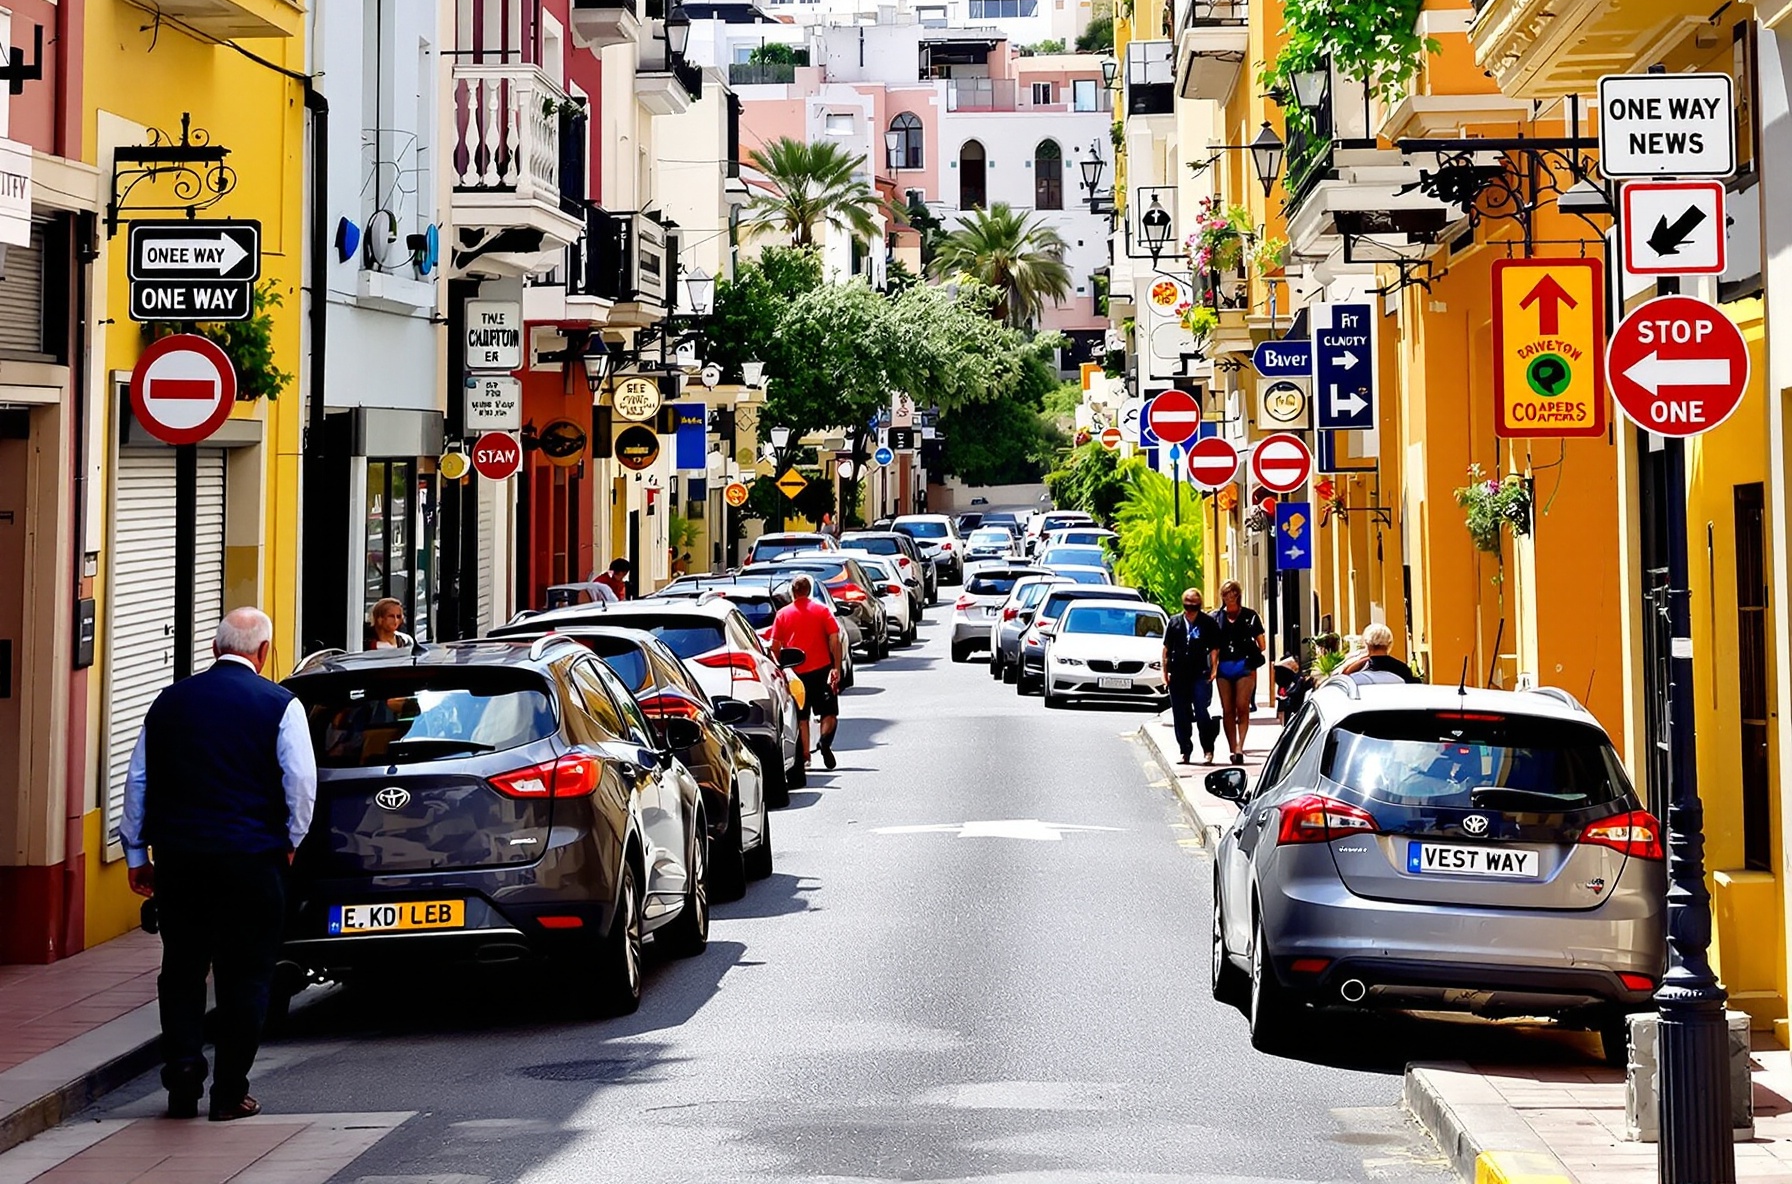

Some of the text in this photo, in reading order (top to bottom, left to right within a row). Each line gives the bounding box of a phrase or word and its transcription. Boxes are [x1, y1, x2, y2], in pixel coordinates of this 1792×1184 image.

[1609, 98, 1721, 120] ONE WAY
[1629, 133, 1704, 155] NEWS
[147, 247, 225, 264] ONEE WAY
[141, 288, 238, 310] ONE WAY
[1637, 319, 1713, 344] STOP
[1650, 400, 1706, 424] ONE
[1424, 847, 1528, 873] VEST WAY
[410, 904, 452, 925] LEB
